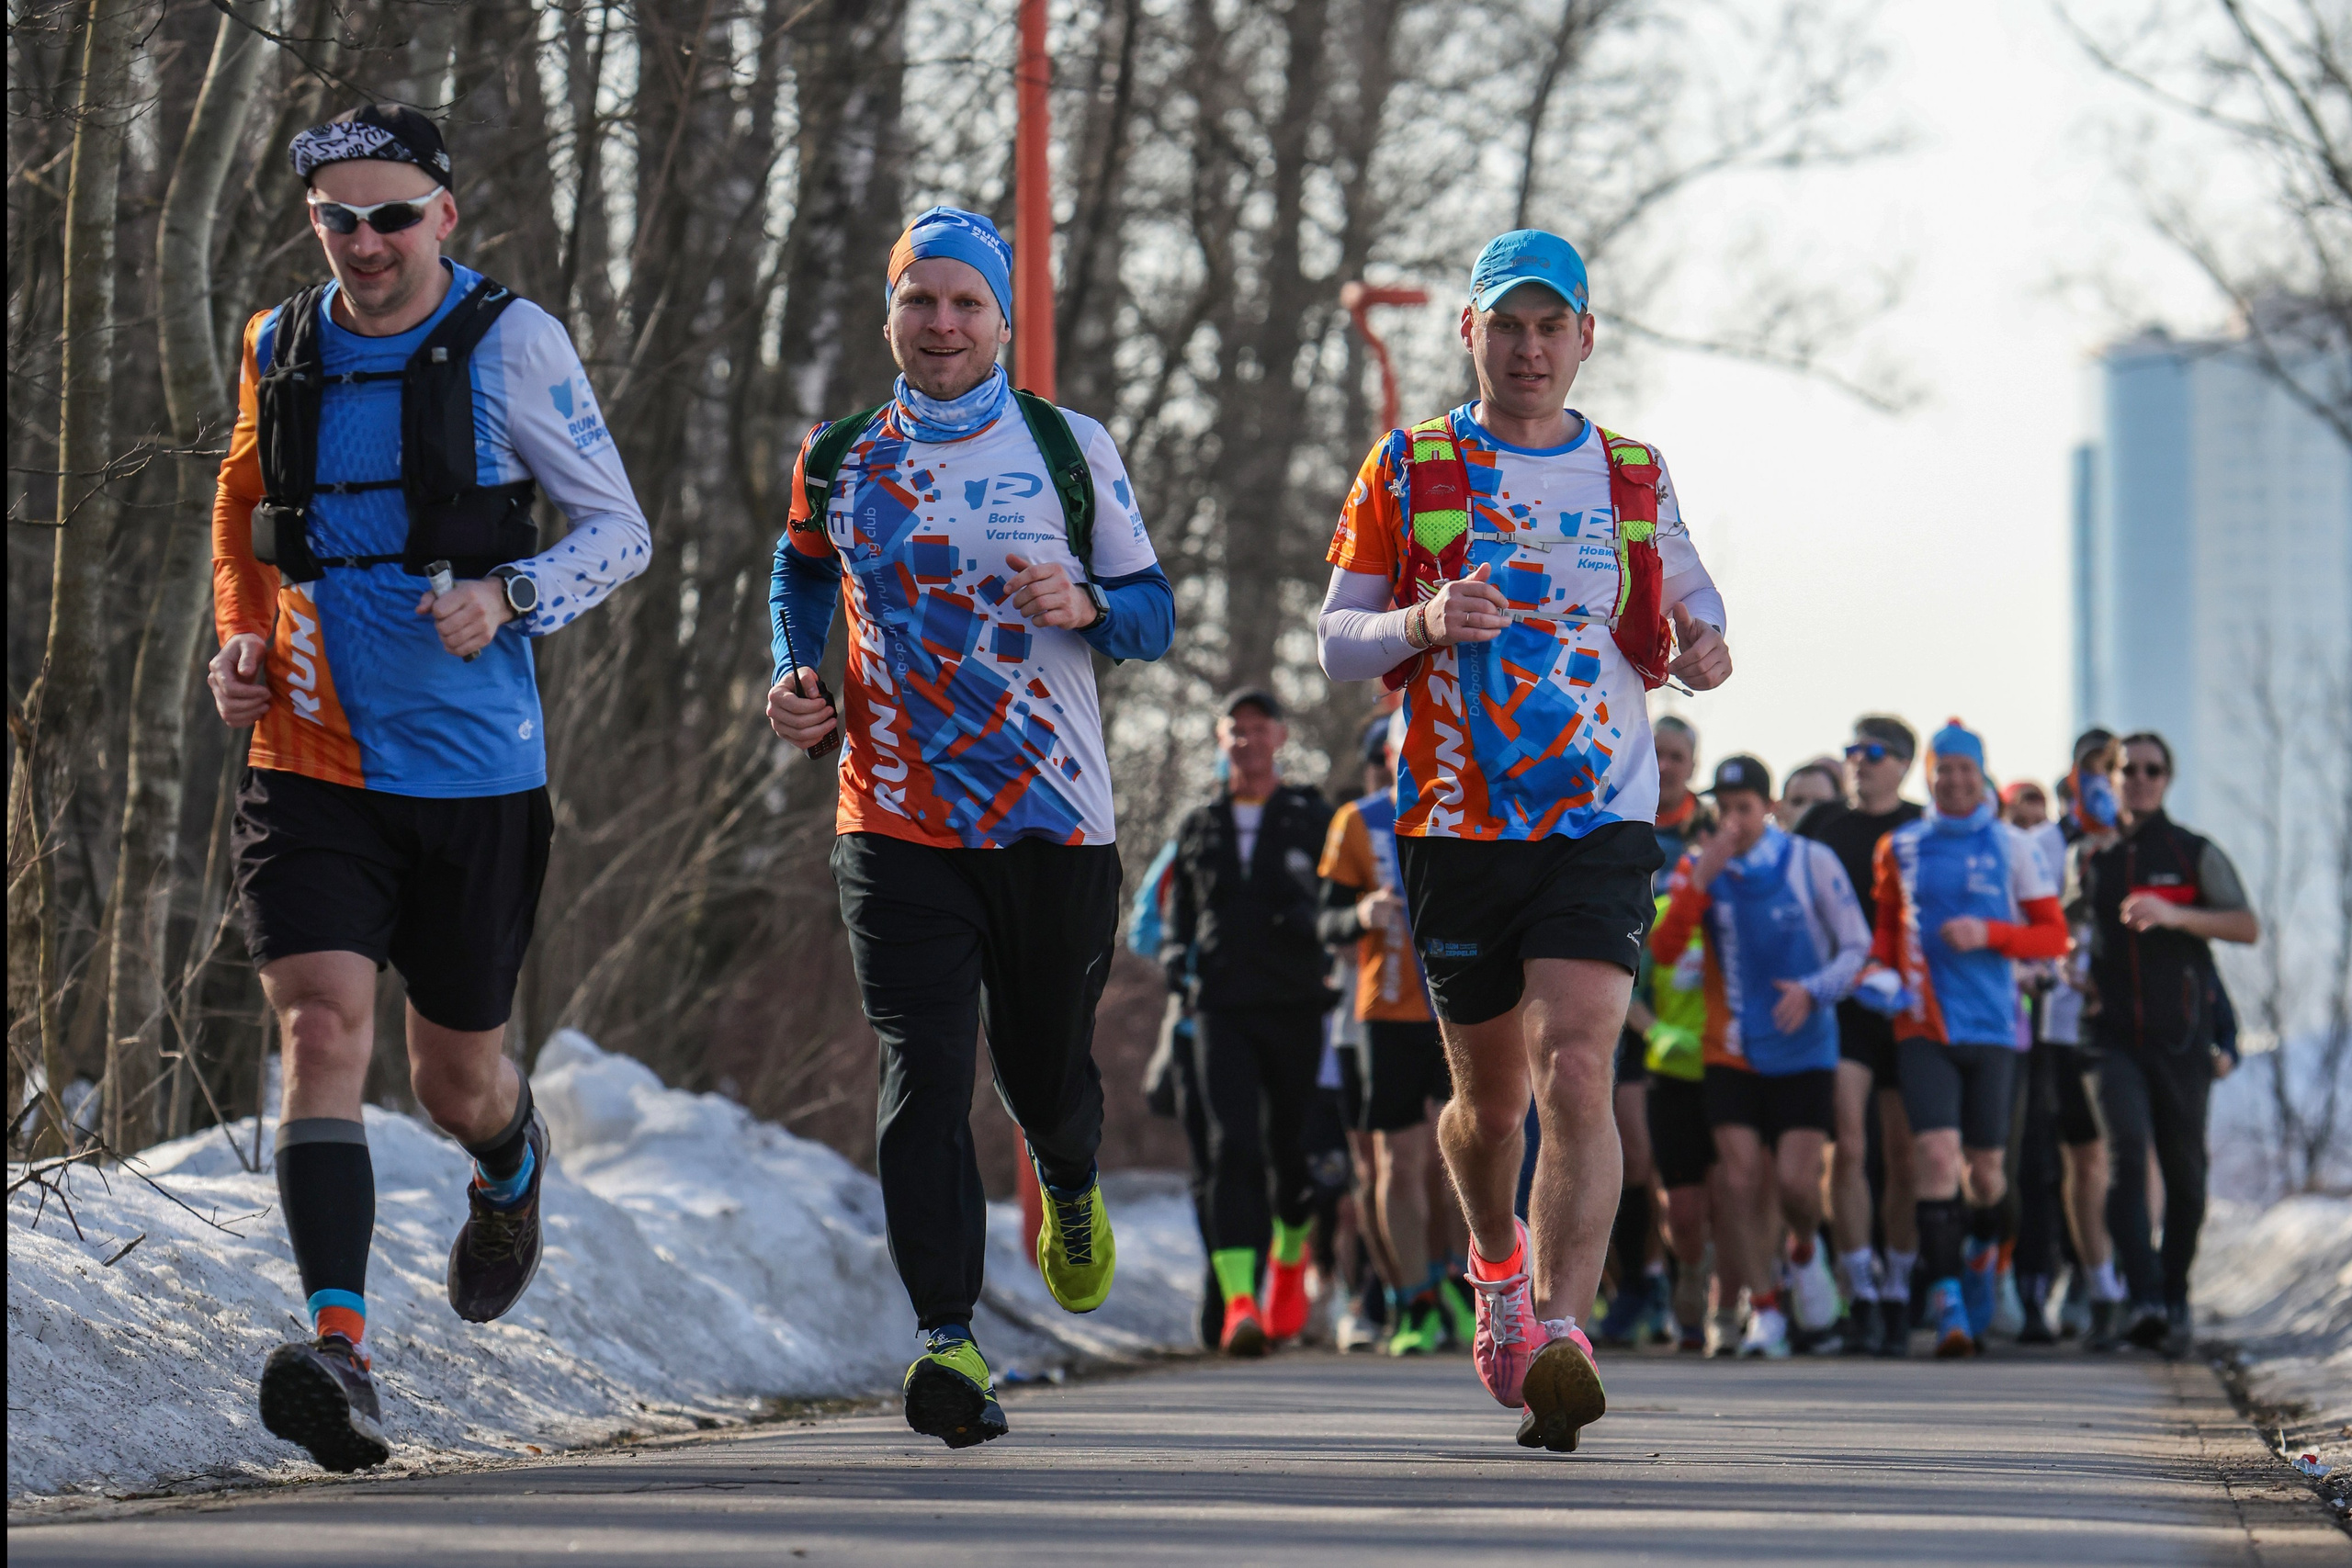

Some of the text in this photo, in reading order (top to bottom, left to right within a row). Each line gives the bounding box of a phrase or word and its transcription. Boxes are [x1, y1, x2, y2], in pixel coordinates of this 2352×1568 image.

[972, 225, 1000, 247] RUN
[568, 413, 596, 436] RUN
[863, 506, 876, 538] club
[988, 512, 1025, 524] Boris
[986, 529, 1055, 543] Vartanyan
[1578, 545, 1615, 558] Нови
[1577, 558, 1620, 571] Кирил
[286, 609, 324, 727] RUN
[868, 699, 911, 820] RUN
[1425, 719, 1466, 838] RUN
